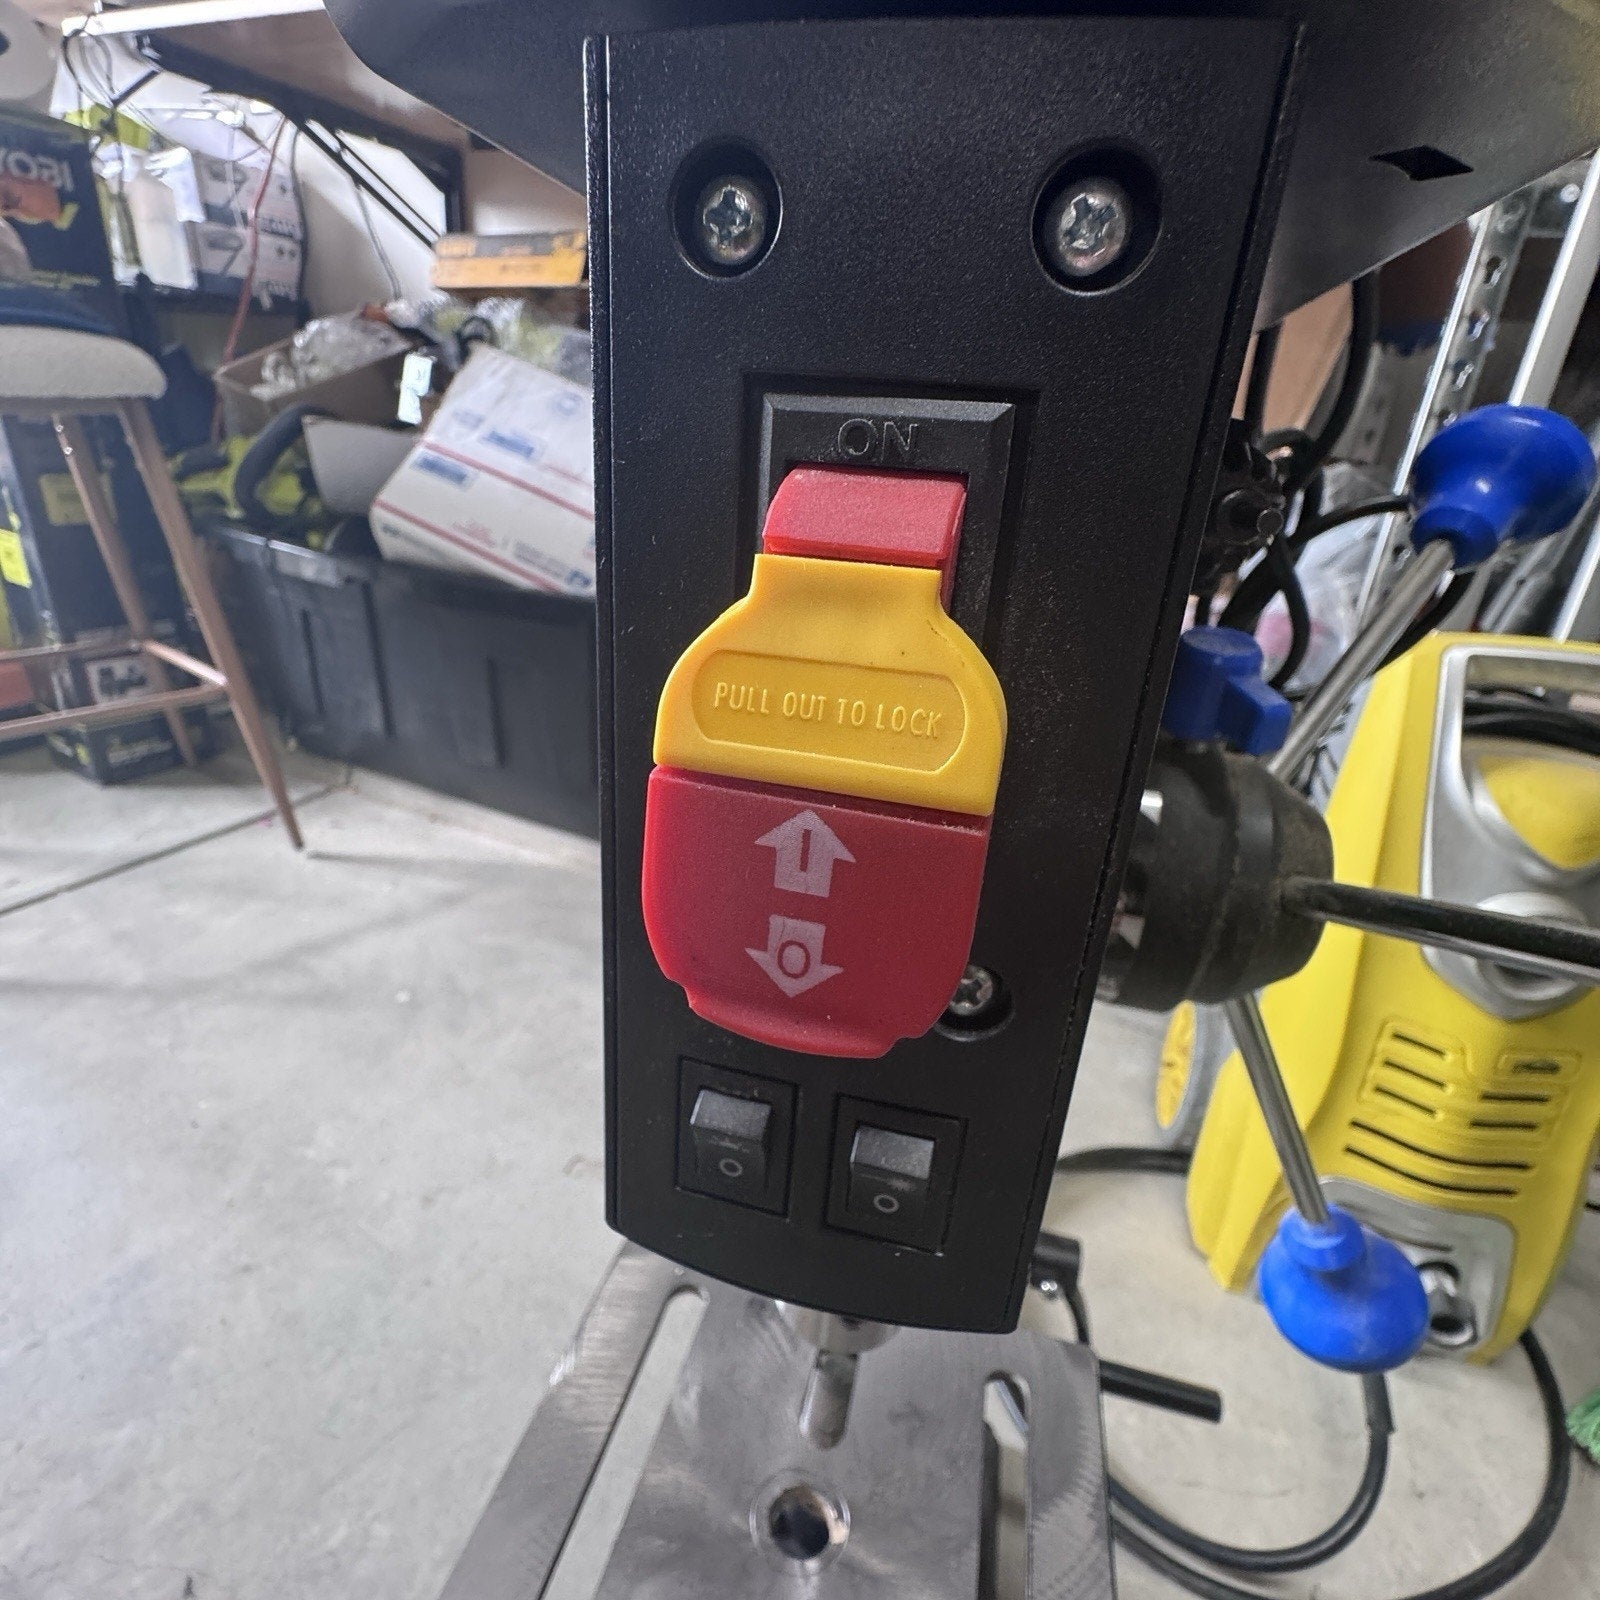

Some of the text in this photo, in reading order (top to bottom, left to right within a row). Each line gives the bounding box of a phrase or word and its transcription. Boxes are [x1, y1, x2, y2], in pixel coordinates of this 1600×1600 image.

[837, 417, 919, 462] ON
[713, 681, 943, 739] PULL OUT TO LOCK
